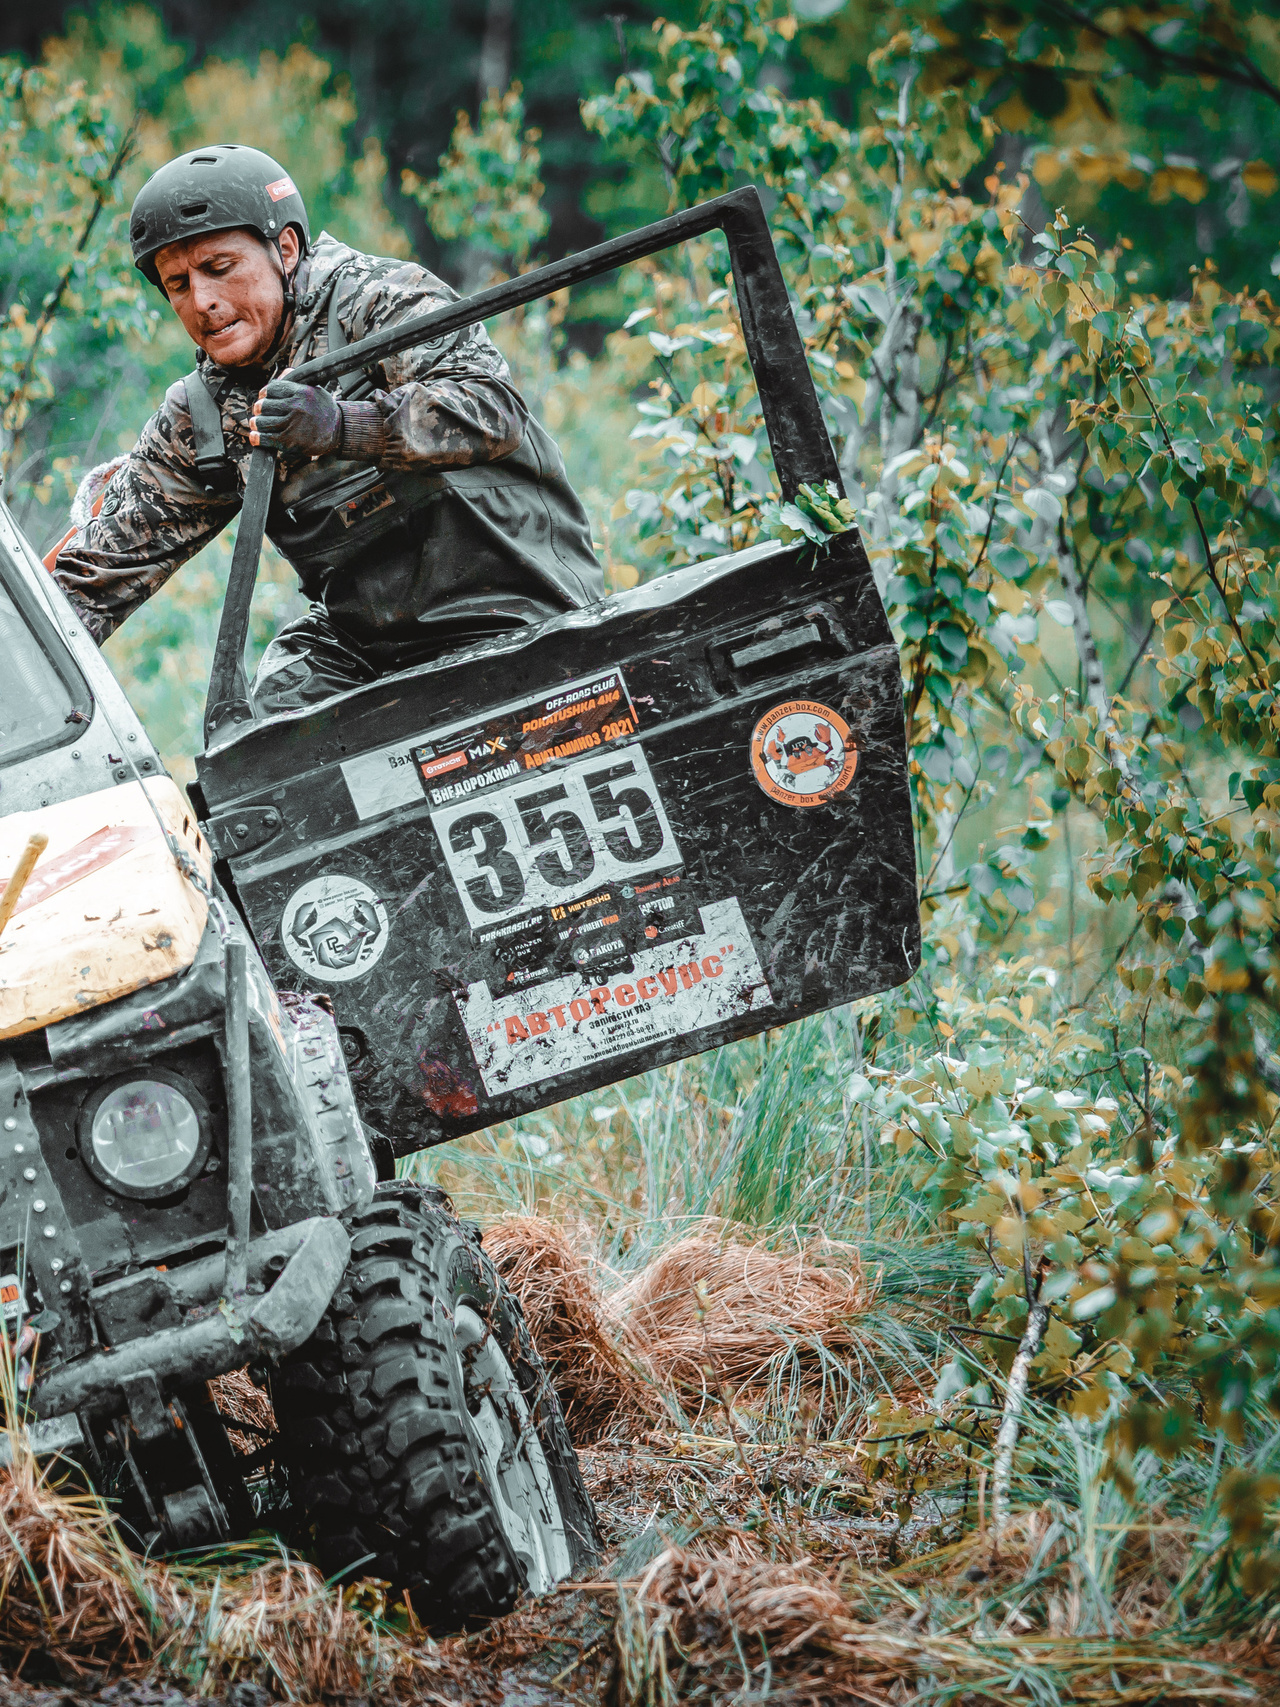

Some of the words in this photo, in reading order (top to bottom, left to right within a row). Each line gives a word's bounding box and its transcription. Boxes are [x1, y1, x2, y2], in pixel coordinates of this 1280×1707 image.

[546, 686, 592, 710] OFF-ROAD
[592, 677, 616, 696] CLUB
[522, 700, 596, 734] POKATUSHKA
[602, 717, 635, 741] 2021
[756, 703, 830, 743] www.panzer-box.com
[448, 760, 664, 914] 355
